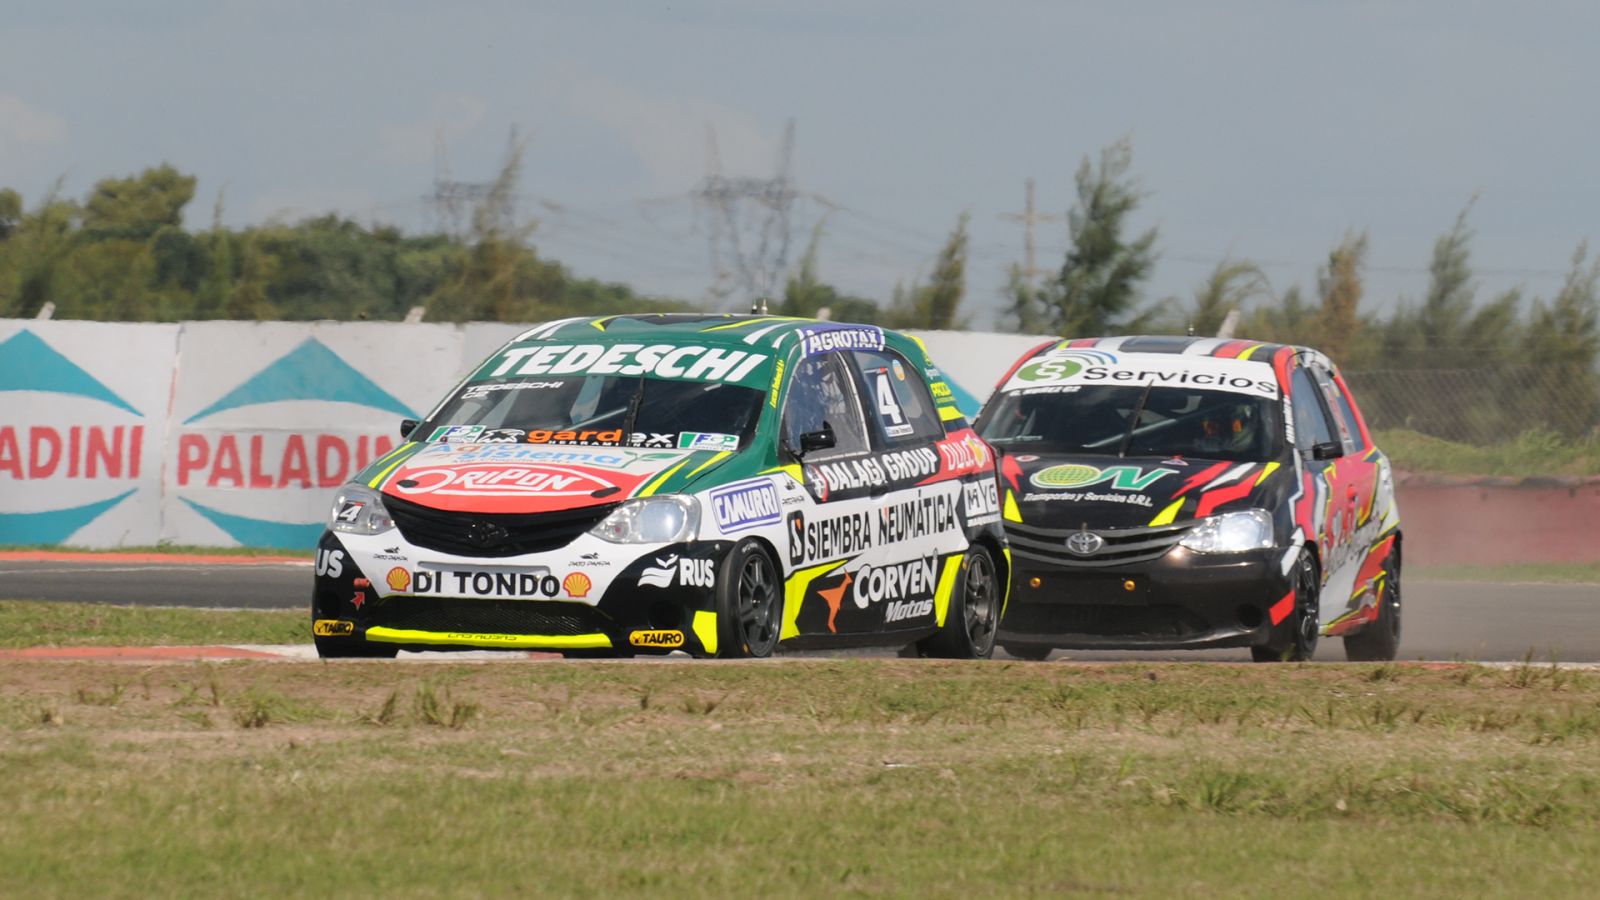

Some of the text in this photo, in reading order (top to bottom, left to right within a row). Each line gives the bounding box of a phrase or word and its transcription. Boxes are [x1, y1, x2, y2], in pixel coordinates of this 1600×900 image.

[806, 329, 879, 354] AGROTAX
[490, 344, 768, 382] TEDESCHI
[466, 381, 564, 393] TEDESCHI
[1083, 367, 1276, 394] Servicios
[877, 374, 903, 424] 4
[819, 457, 888, 491] DALAGI
[882, 447, 938, 481] GROUP
[338, 505, 363, 521] 4
[807, 511, 872, 561] SIEMBRA
[877, 489, 956, 546] NEUMÁTICA
[412, 570, 561, 598] DI TONDO
[679, 557, 715, 588] RUS
[853, 548, 938, 609] CORVEN
[883, 599, 934, 623] Motos
[642, 633, 682, 644] TAURO
